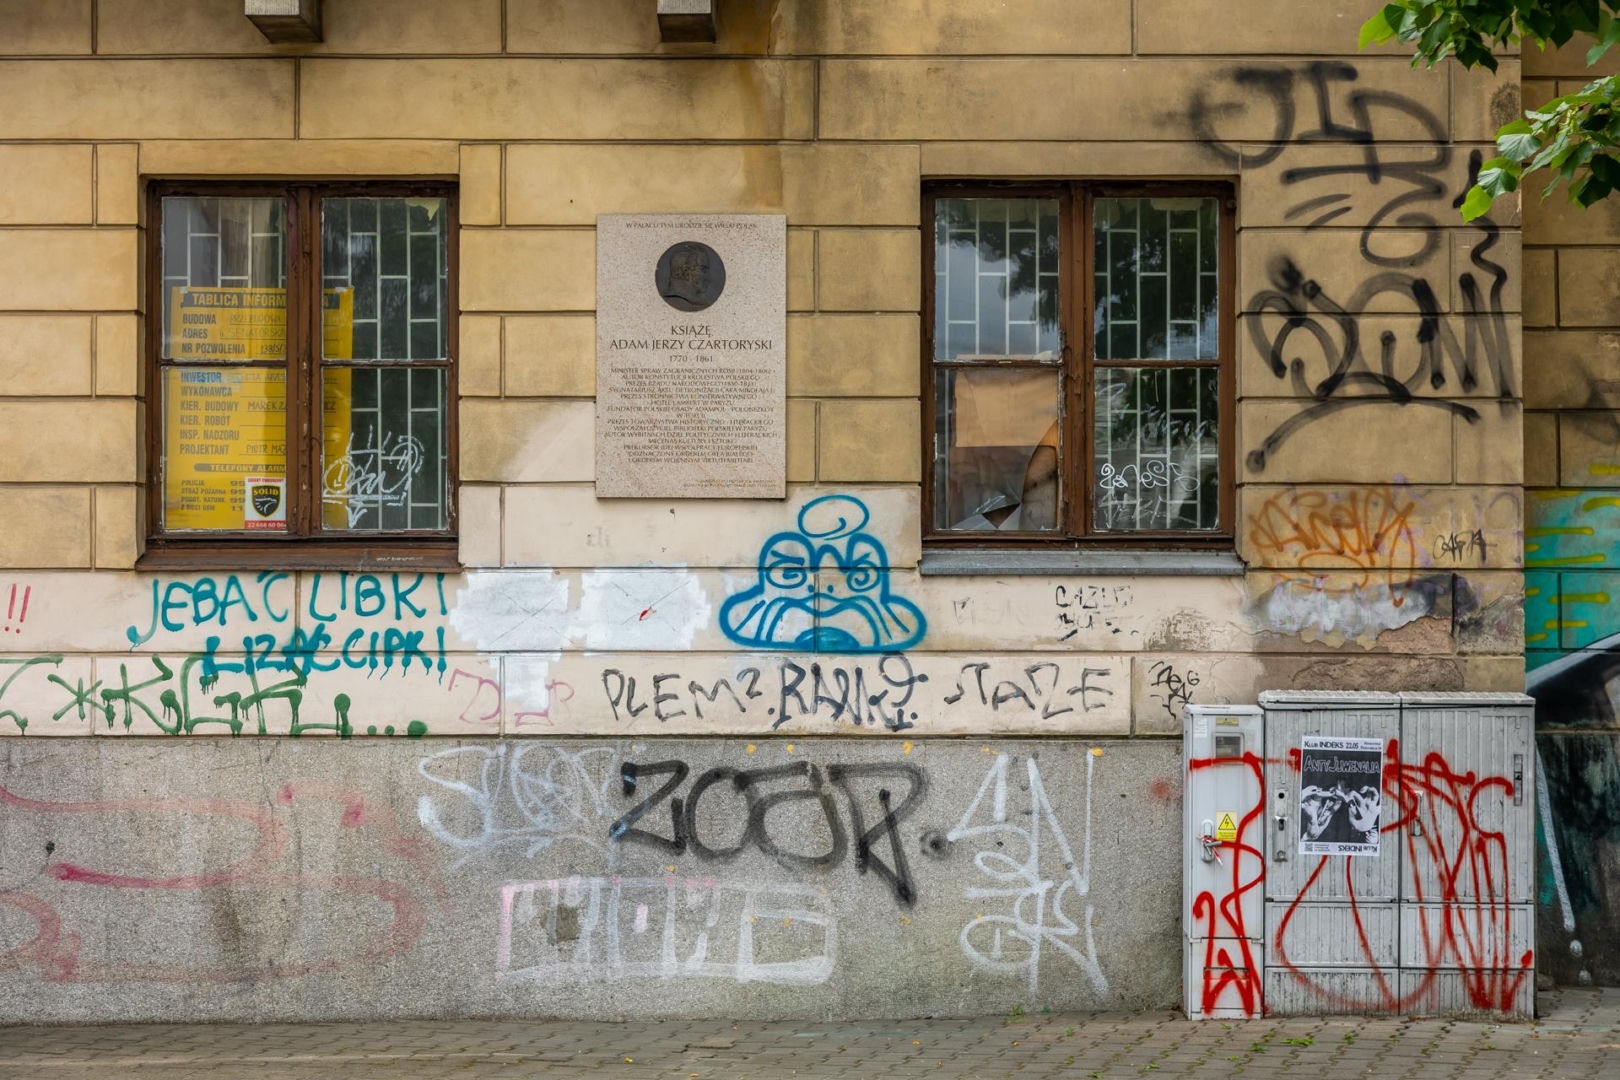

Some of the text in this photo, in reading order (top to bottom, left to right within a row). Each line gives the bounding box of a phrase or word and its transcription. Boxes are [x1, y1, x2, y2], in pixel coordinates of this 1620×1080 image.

[192, 293, 238, 306] TABLICA
[183, 313, 217, 325] BUDOWA
[182, 328, 208, 339] ADRES
[671, 324, 711, 337] KSIĄŻĘ
[181, 343, 246, 355] NR POZWOLENIA
[610, 339, 772, 351] ADAM JERZY CZARTORYSKI
[669, 355, 688, 363] 1770
[696, 355, 713, 363] 1861
[180, 371, 222, 383] INWESTOR
[180, 385, 233, 397] WYKONAWCA
[180, 400, 240, 412] KIER. BUDOWY
[248, 401, 277, 411] MAREK
[180, 413, 232, 426] KIER. ROBÓT
[180, 429, 240, 441] INSP. NADZORU
[180, 443, 230, 455] PROJEKTANT
[211, 464, 253, 472] TELEFONY
[253, 488, 279, 496] SOLID
[126, 569, 290, 652] JEBAĆ
[1319, 741, 1344, 749] INDEKS
